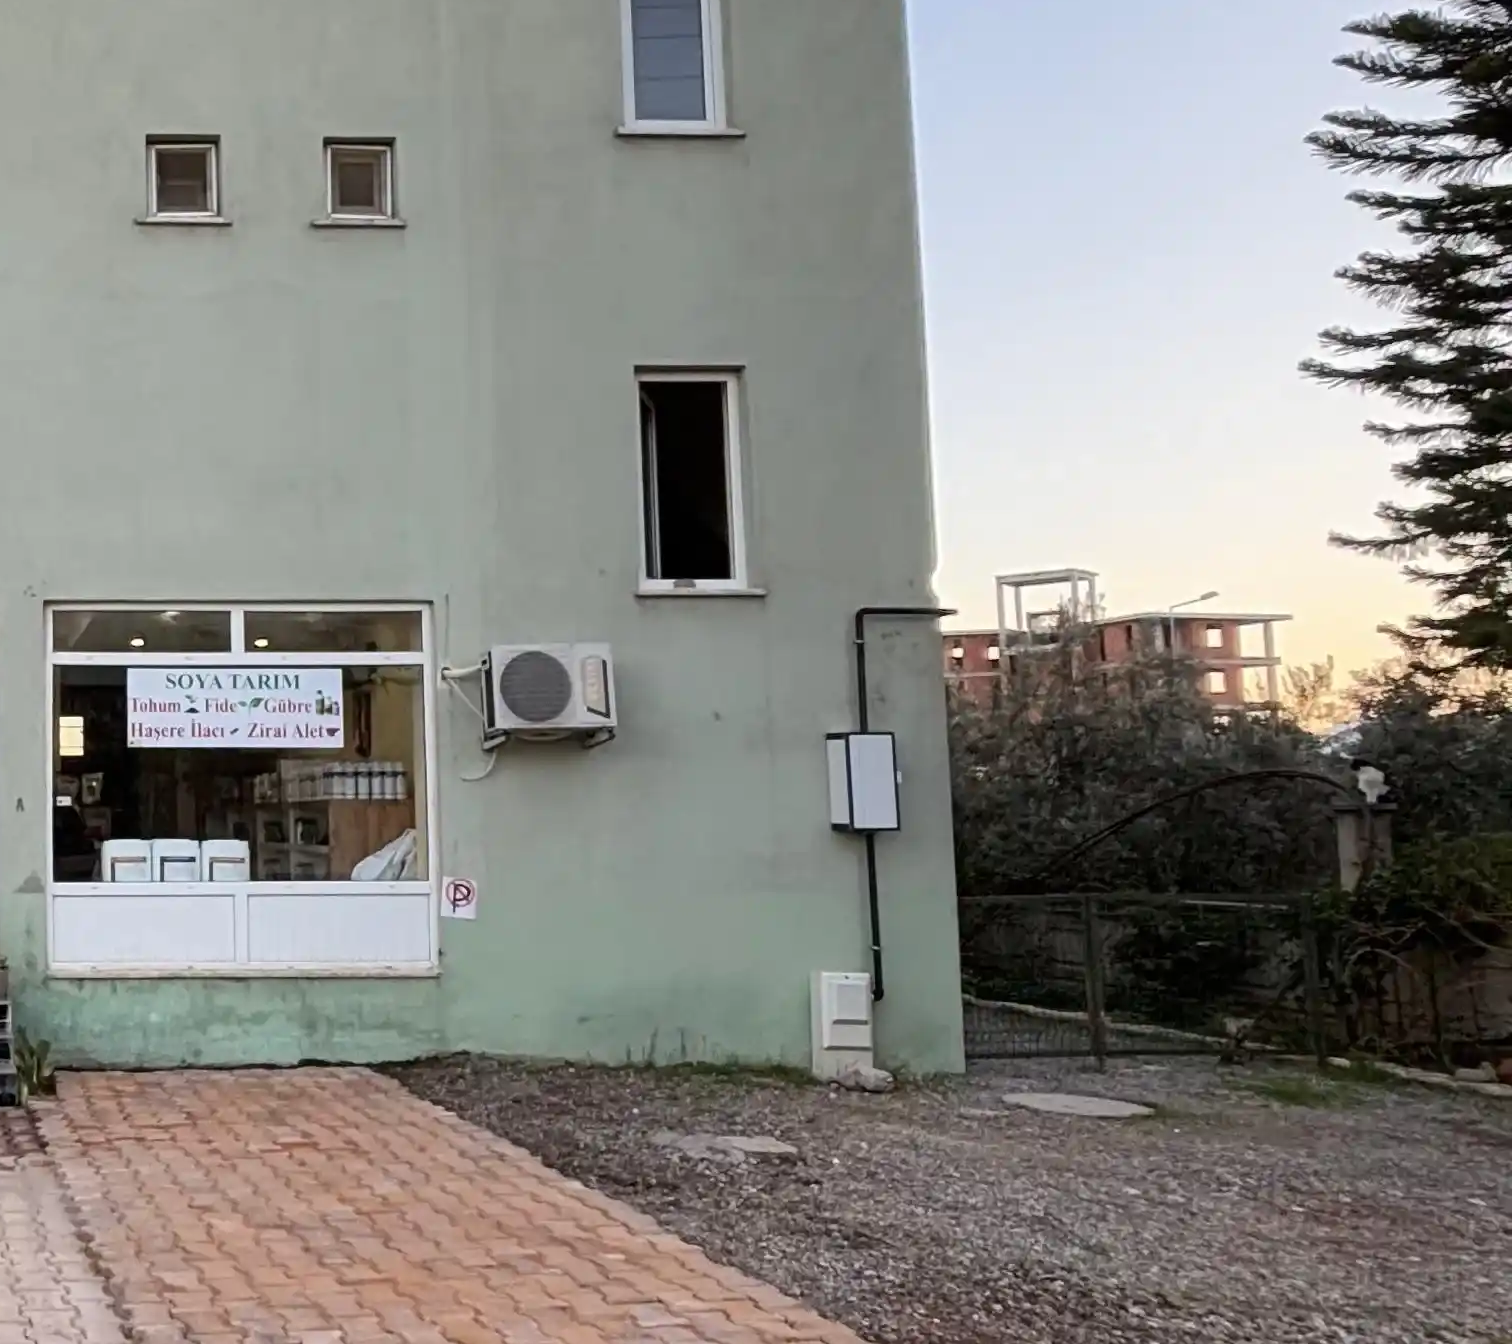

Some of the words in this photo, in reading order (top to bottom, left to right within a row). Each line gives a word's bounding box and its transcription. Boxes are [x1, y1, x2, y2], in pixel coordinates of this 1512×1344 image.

[165, 673, 222, 690] SOYA
[228, 673, 300, 690] TARIM
[131, 697, 181, 713] Tohum
[205, 698, 237, 713] Fide
[264, 697, 313, 714] Gübre
[131, 722, 185, 740] Haşere
[191, 718, 225, 738] İlacı
[247, 722, 287, 738] Zirai
[292, 722, 324, 738] Alet
